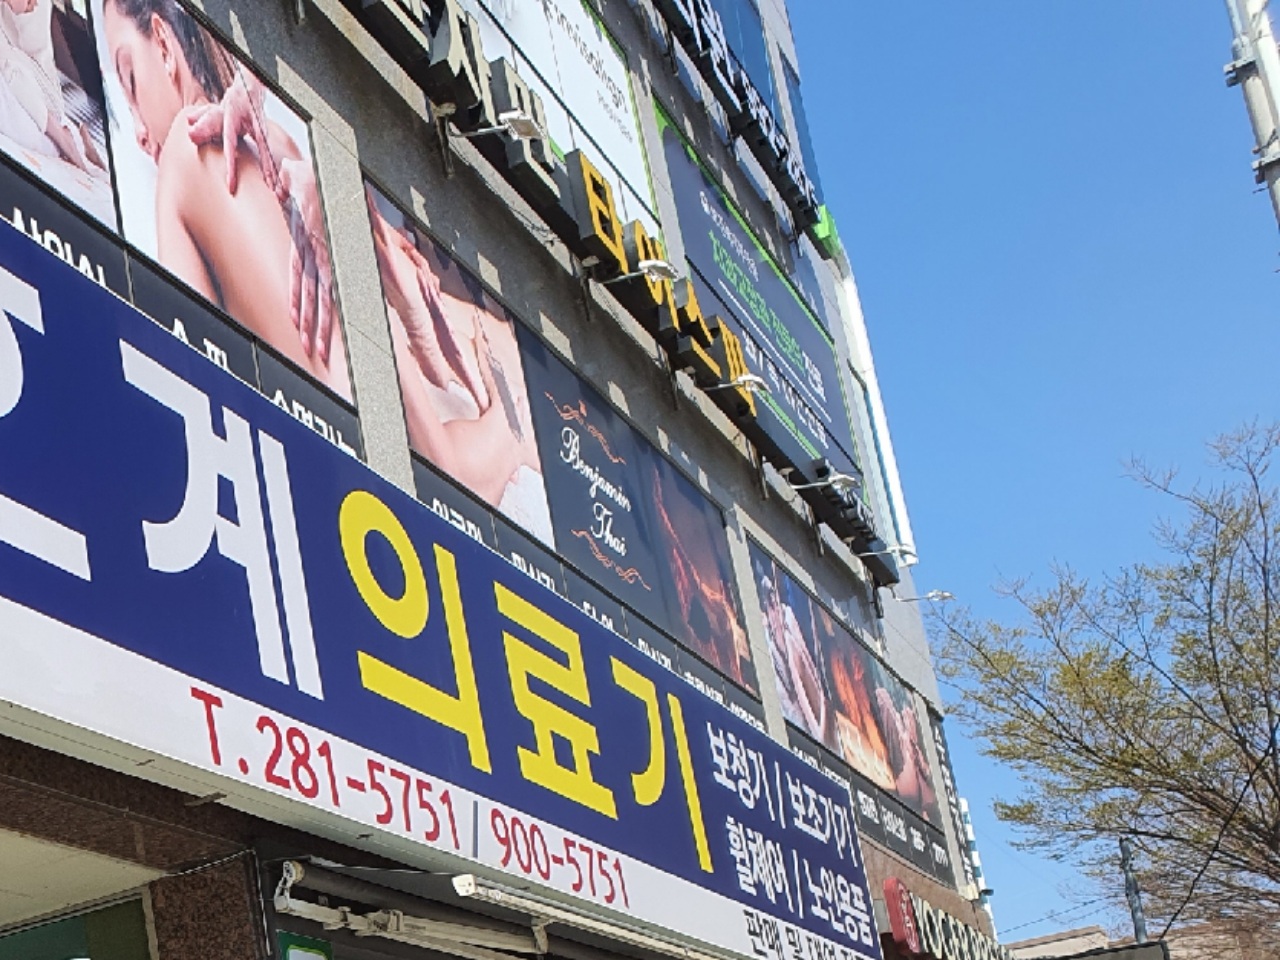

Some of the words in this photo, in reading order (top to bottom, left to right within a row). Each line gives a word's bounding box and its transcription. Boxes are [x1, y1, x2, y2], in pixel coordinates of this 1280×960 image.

[560, 426, 631, 513] Benjamin
[590, 501, 627, 557] Thai
[706, 721, 775, 822] 보청기
[785, 771, 858, 867] 보조기기
[491, 808, 630, 908] 900-5751
[726, 815, 794, 913] 휠체어
[803, 858, 874, 946] 노인용품
